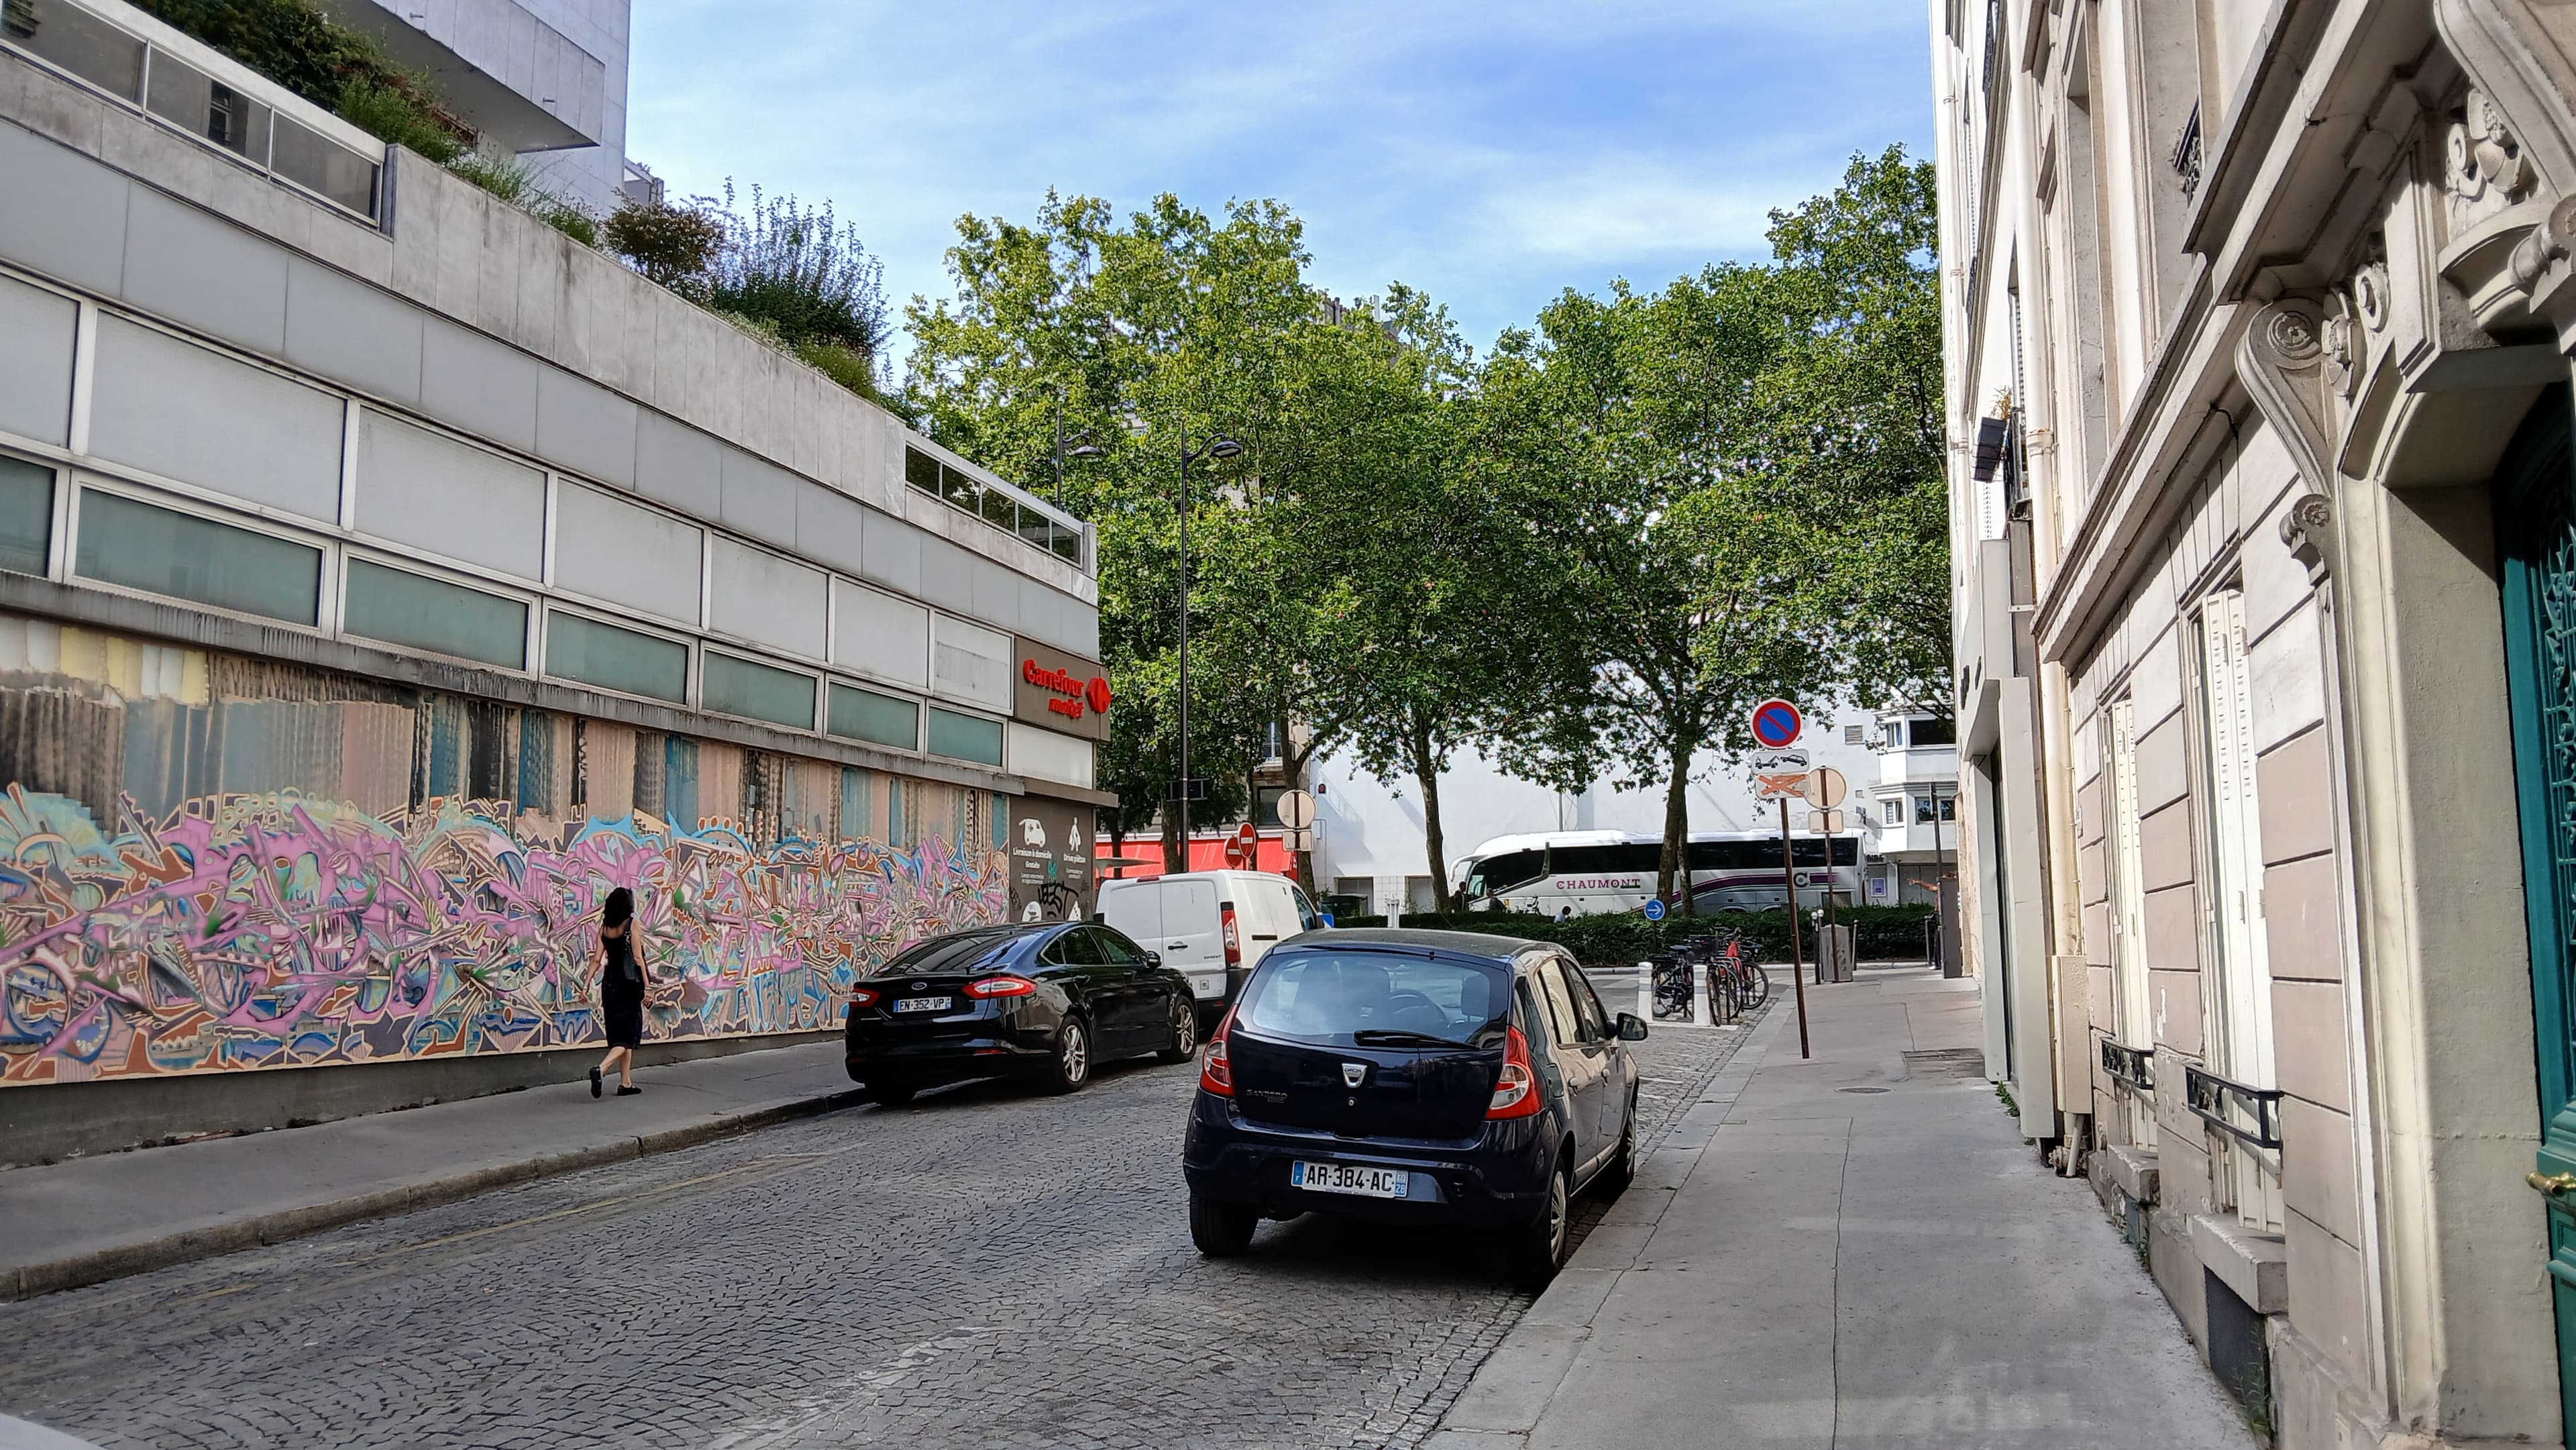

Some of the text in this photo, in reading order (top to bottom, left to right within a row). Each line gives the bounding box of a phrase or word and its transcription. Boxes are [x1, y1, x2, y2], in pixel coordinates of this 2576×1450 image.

[1022, 658, 1085, 698] Carrefour
[1049, 698, 1084, 719] market
[1556, 878, 1640, 890] CHAUMONT
[1246, 1089, 1288, 1100] SANDERO
[1306, 1165, 1393, 1192] AR-384-AC
